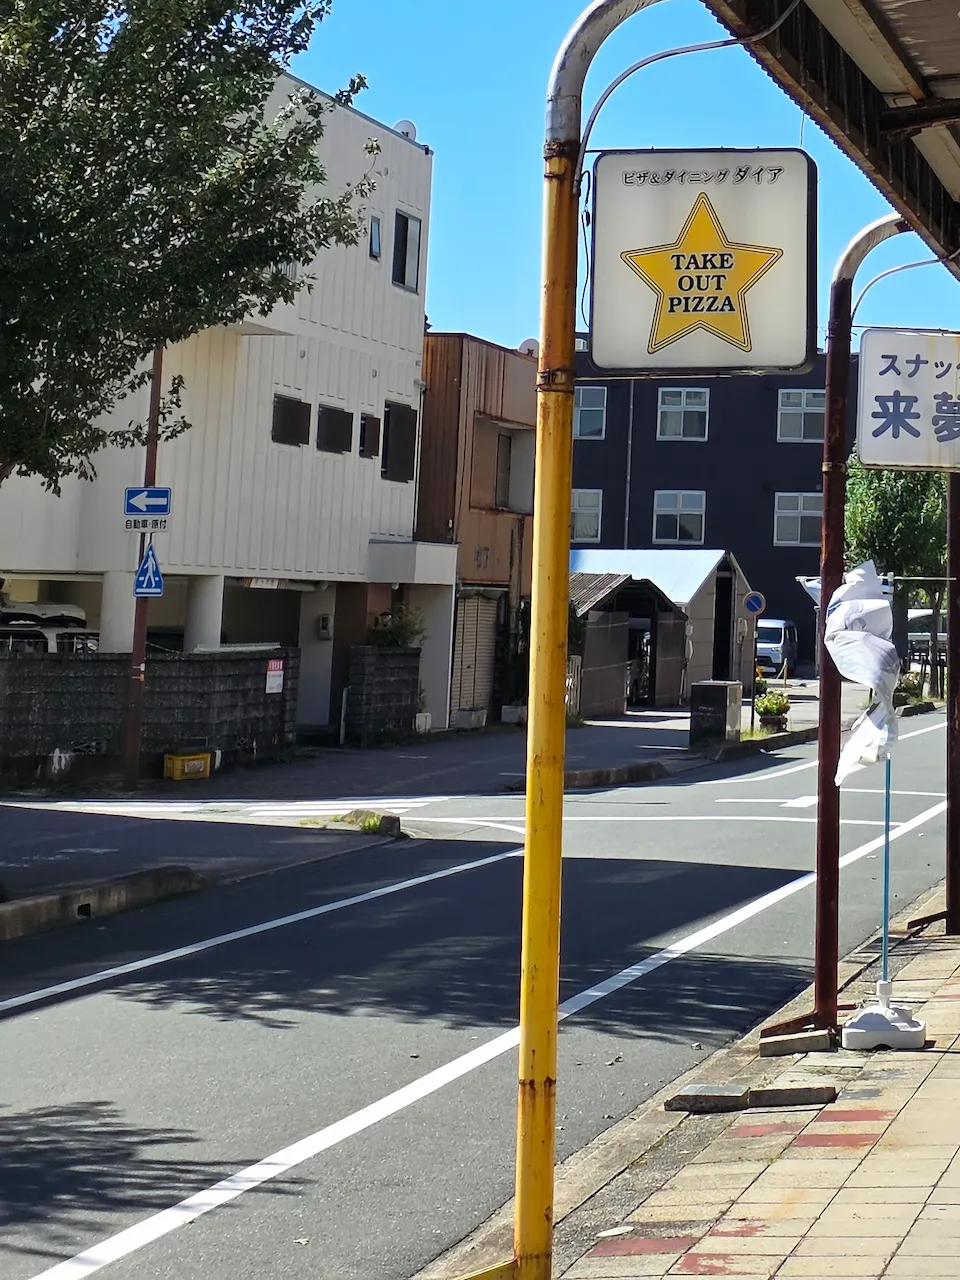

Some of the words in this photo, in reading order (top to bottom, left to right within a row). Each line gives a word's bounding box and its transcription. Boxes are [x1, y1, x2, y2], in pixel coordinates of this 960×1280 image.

[623, 169, 730, 186] ピザ&ダイニング
[732, 165, 784, 185] ダイア
[671, 253, 734, 270] TAKE
[678, 275, 726, 291] OUT
[668, 296, 735, 313] PIZZA
